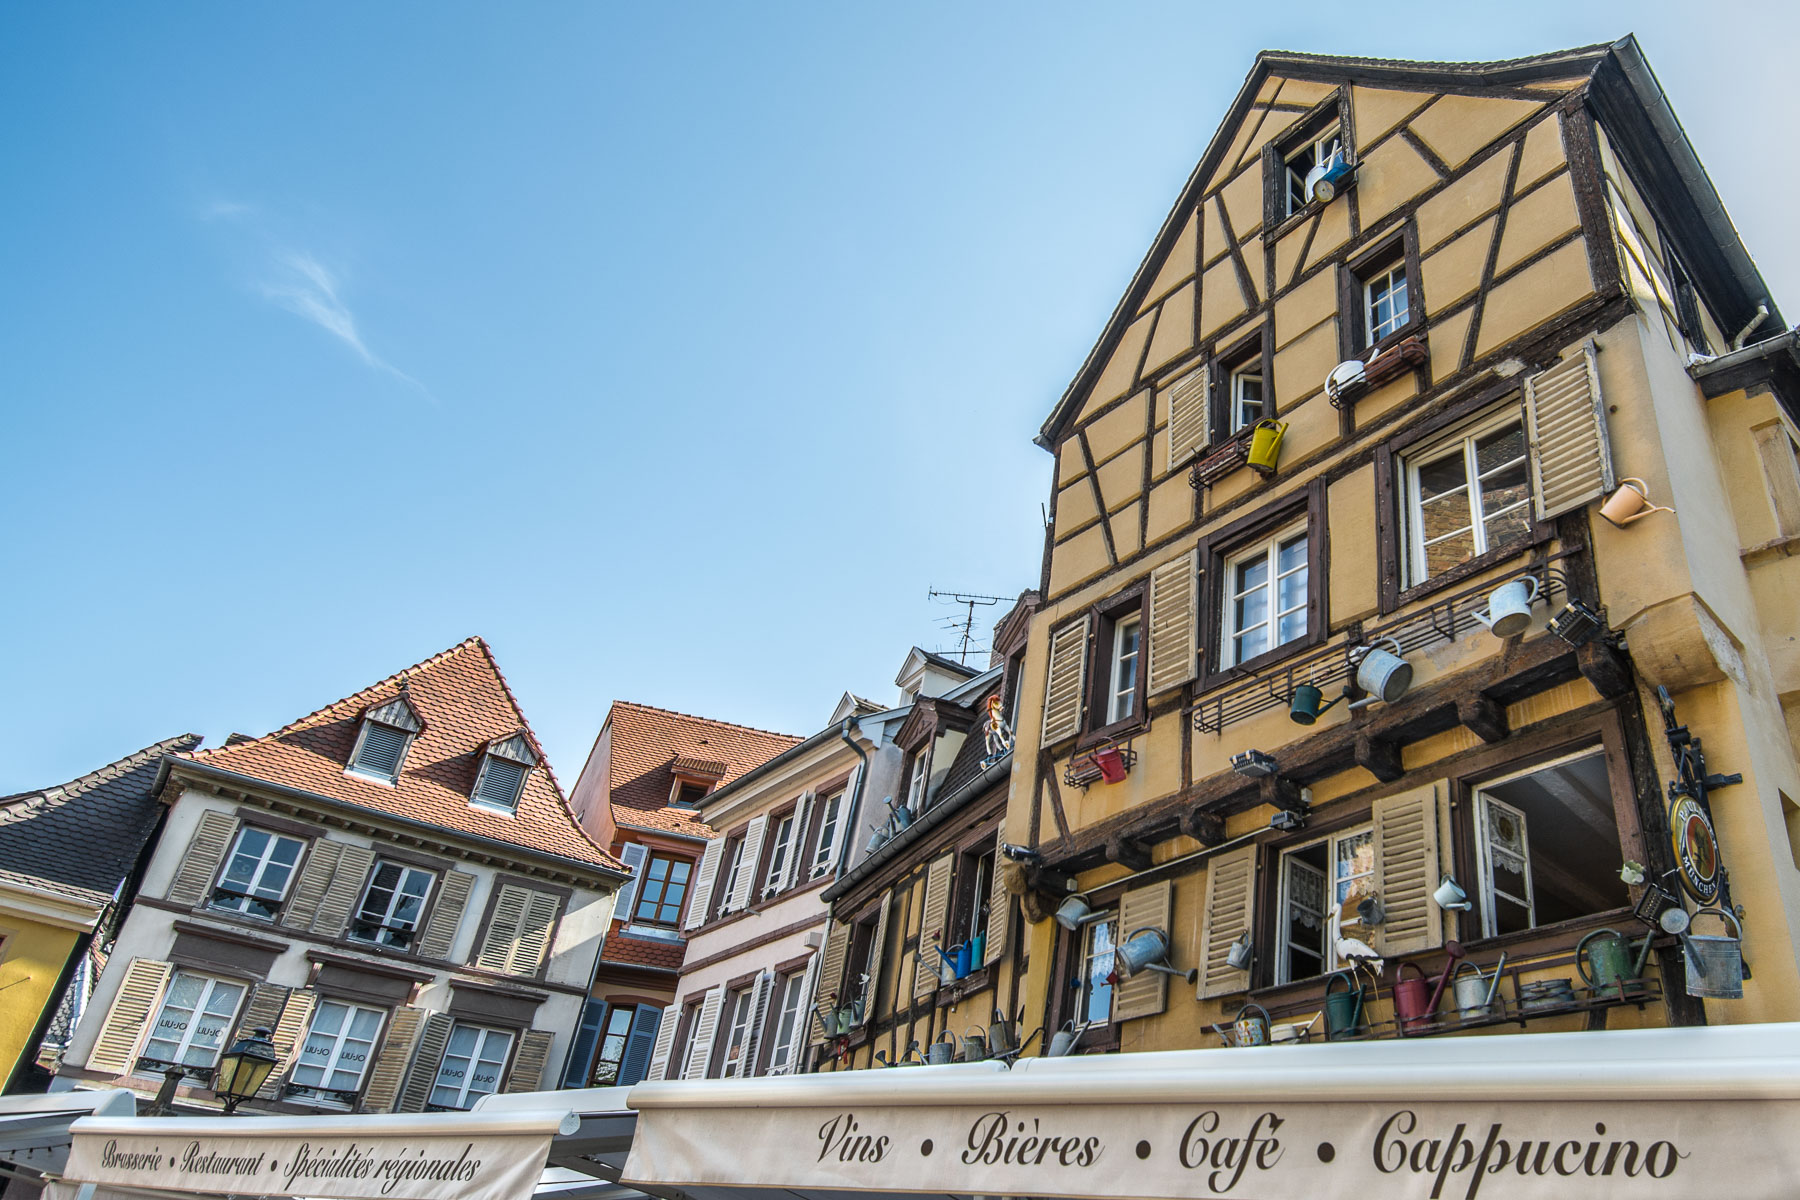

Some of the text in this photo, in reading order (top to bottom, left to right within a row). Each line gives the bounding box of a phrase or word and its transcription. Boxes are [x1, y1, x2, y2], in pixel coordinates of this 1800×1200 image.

[101, 1138, 482, 1195] Brasserie Restaurant Spécialités régionales
[817, 1110, 1692, 1200] Vins Bières Café Cappucino
